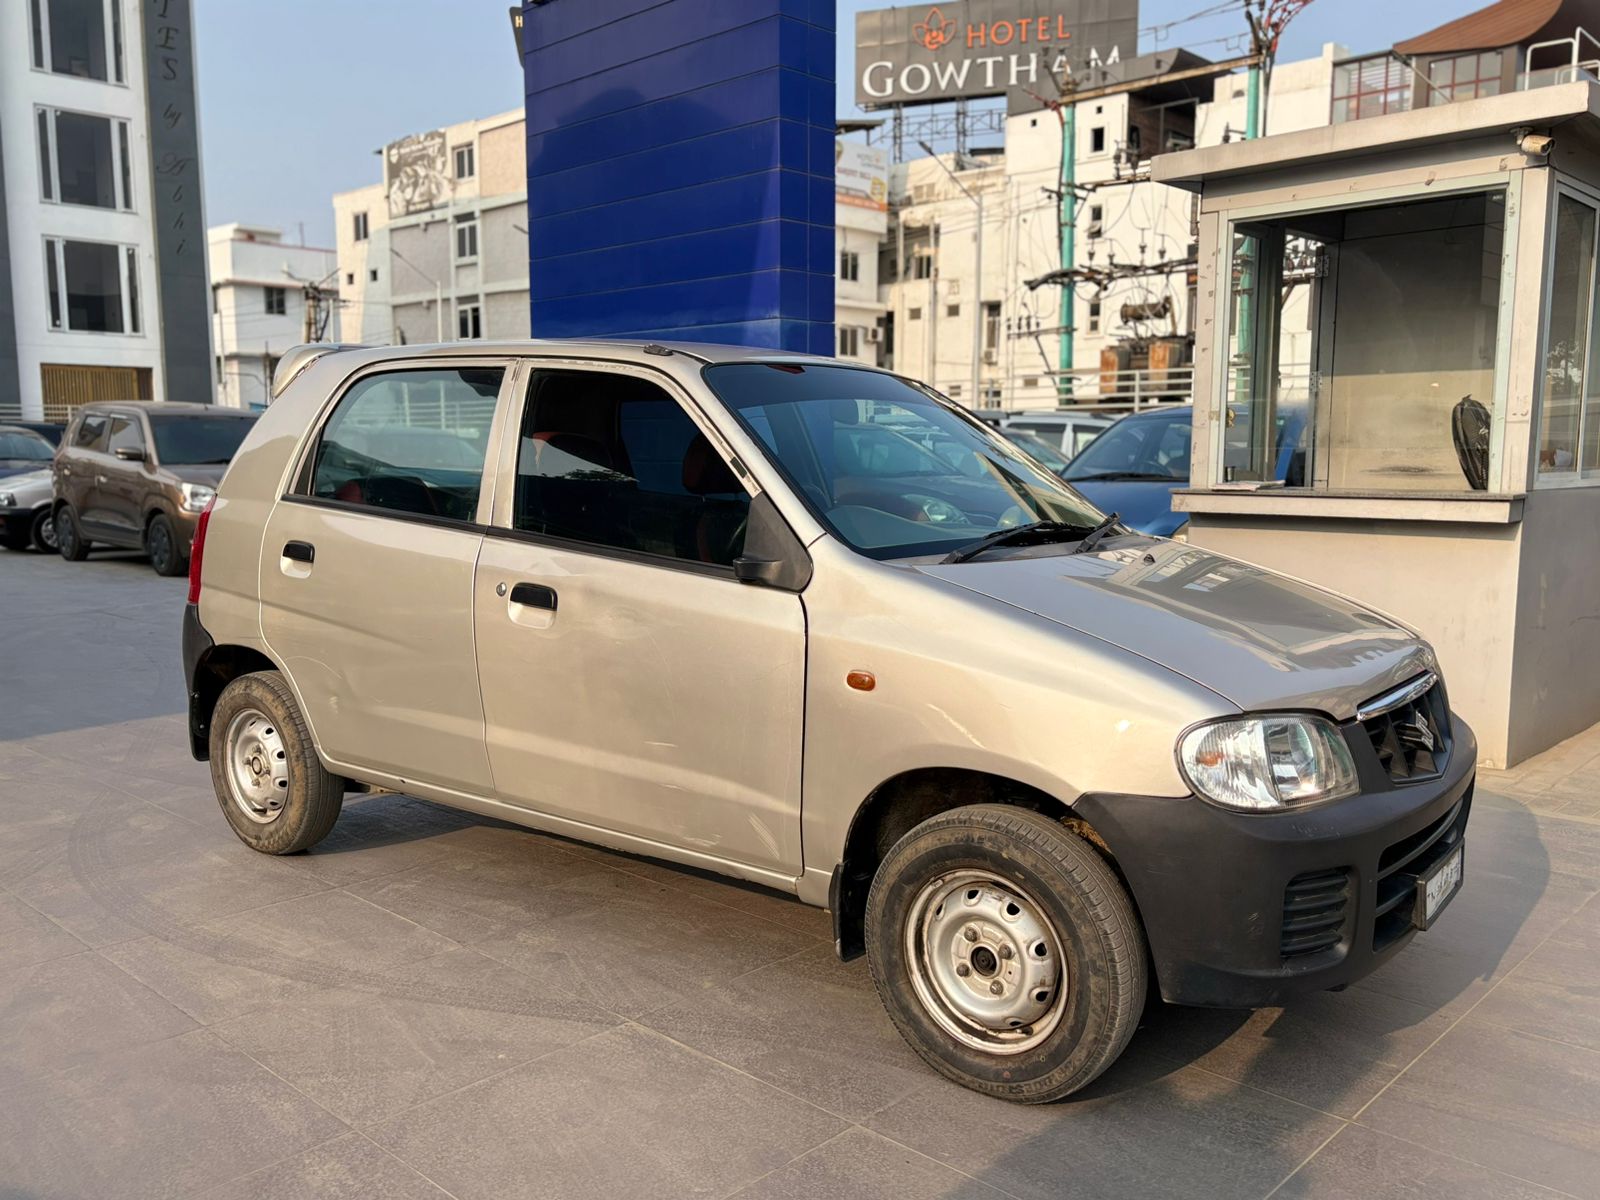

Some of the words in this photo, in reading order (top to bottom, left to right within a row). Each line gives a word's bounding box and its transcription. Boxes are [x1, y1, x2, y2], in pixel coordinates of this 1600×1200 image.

[967, 14, 1071, 49] HOTEL
[862, 45, 1120, 98] GOWTHAM
[163, 103, 182, 129] by
